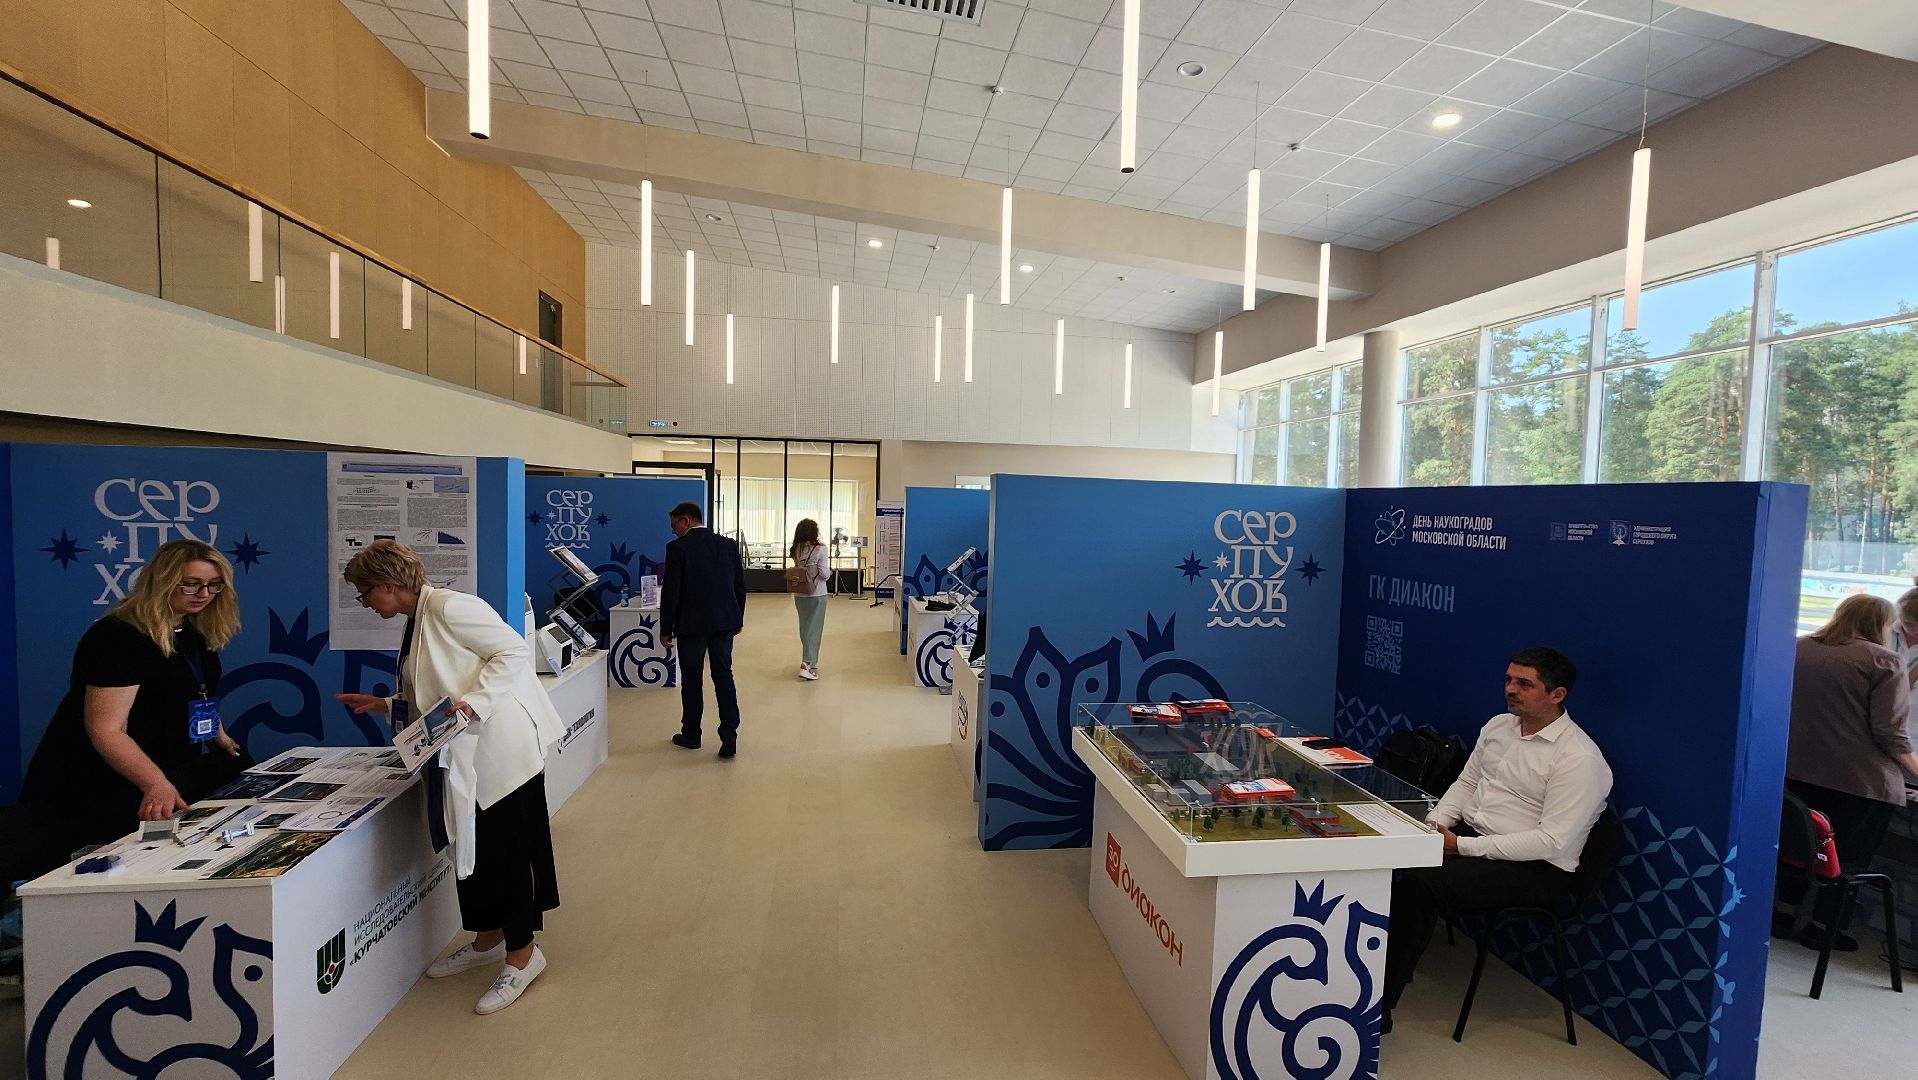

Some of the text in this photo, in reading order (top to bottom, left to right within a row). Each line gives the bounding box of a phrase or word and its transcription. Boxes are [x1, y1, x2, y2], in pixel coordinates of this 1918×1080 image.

[545, 523, 591, 541] ХОВ
[1412, 514, 1493, 532] ДЕНЬ НАУКОГРАДОВ
[1411, 530, 1507, 551] МОСКОВСКОЙ ОБЛАСТИ
[1229, 545, 1294, 579] ПУ
[1207, 578, 1288, 613] ХОВ
[1369, 574, 1455, 613] ГК ДИАКОН
